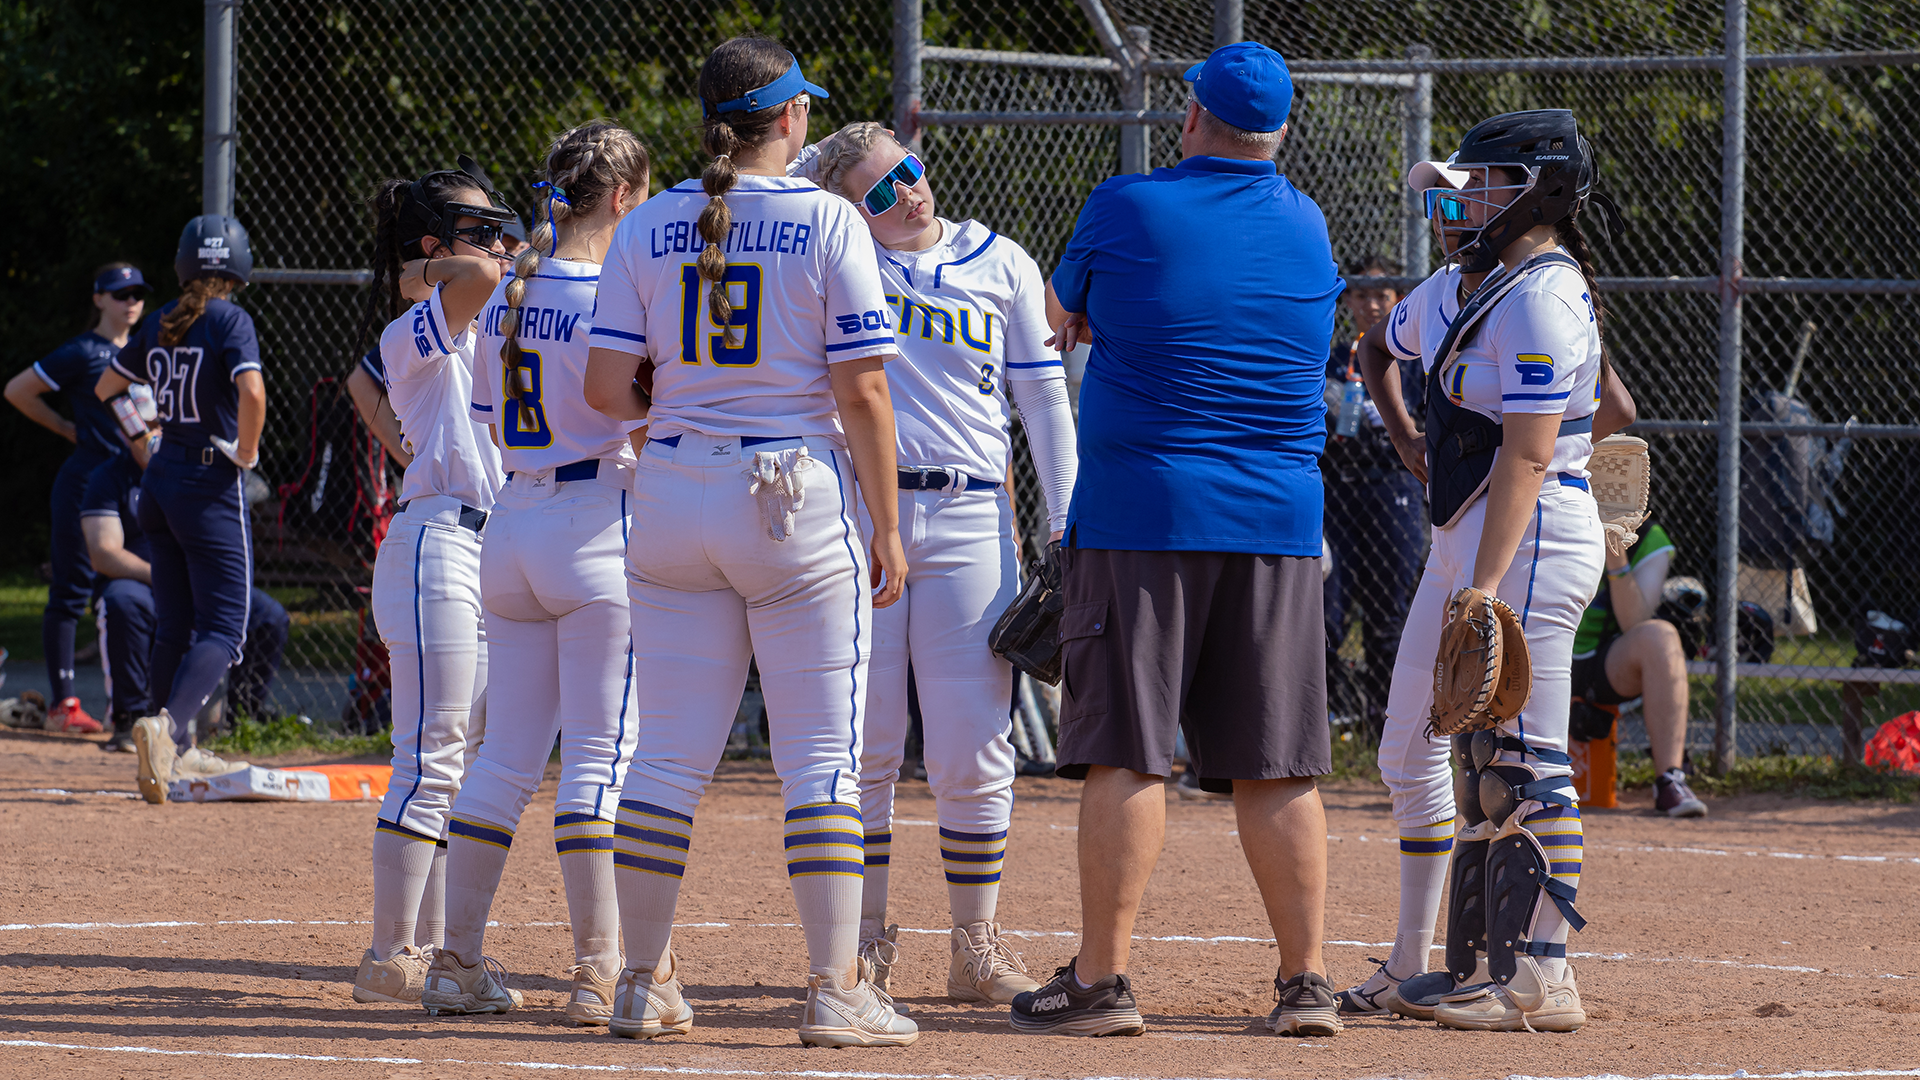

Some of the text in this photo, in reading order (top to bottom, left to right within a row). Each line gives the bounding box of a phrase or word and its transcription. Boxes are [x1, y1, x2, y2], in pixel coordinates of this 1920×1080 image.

[651, 220, 811, 258] LEBOTILLIER
[679, 262, 764, 368] 19
[884, 293, 994, 355] MU
[146, 346, 204, 423] 27
[502, 348, 555, 450] 8
[978, 362, 995, 396] 9
[1031, 992, 1069, 1013] HOKA
